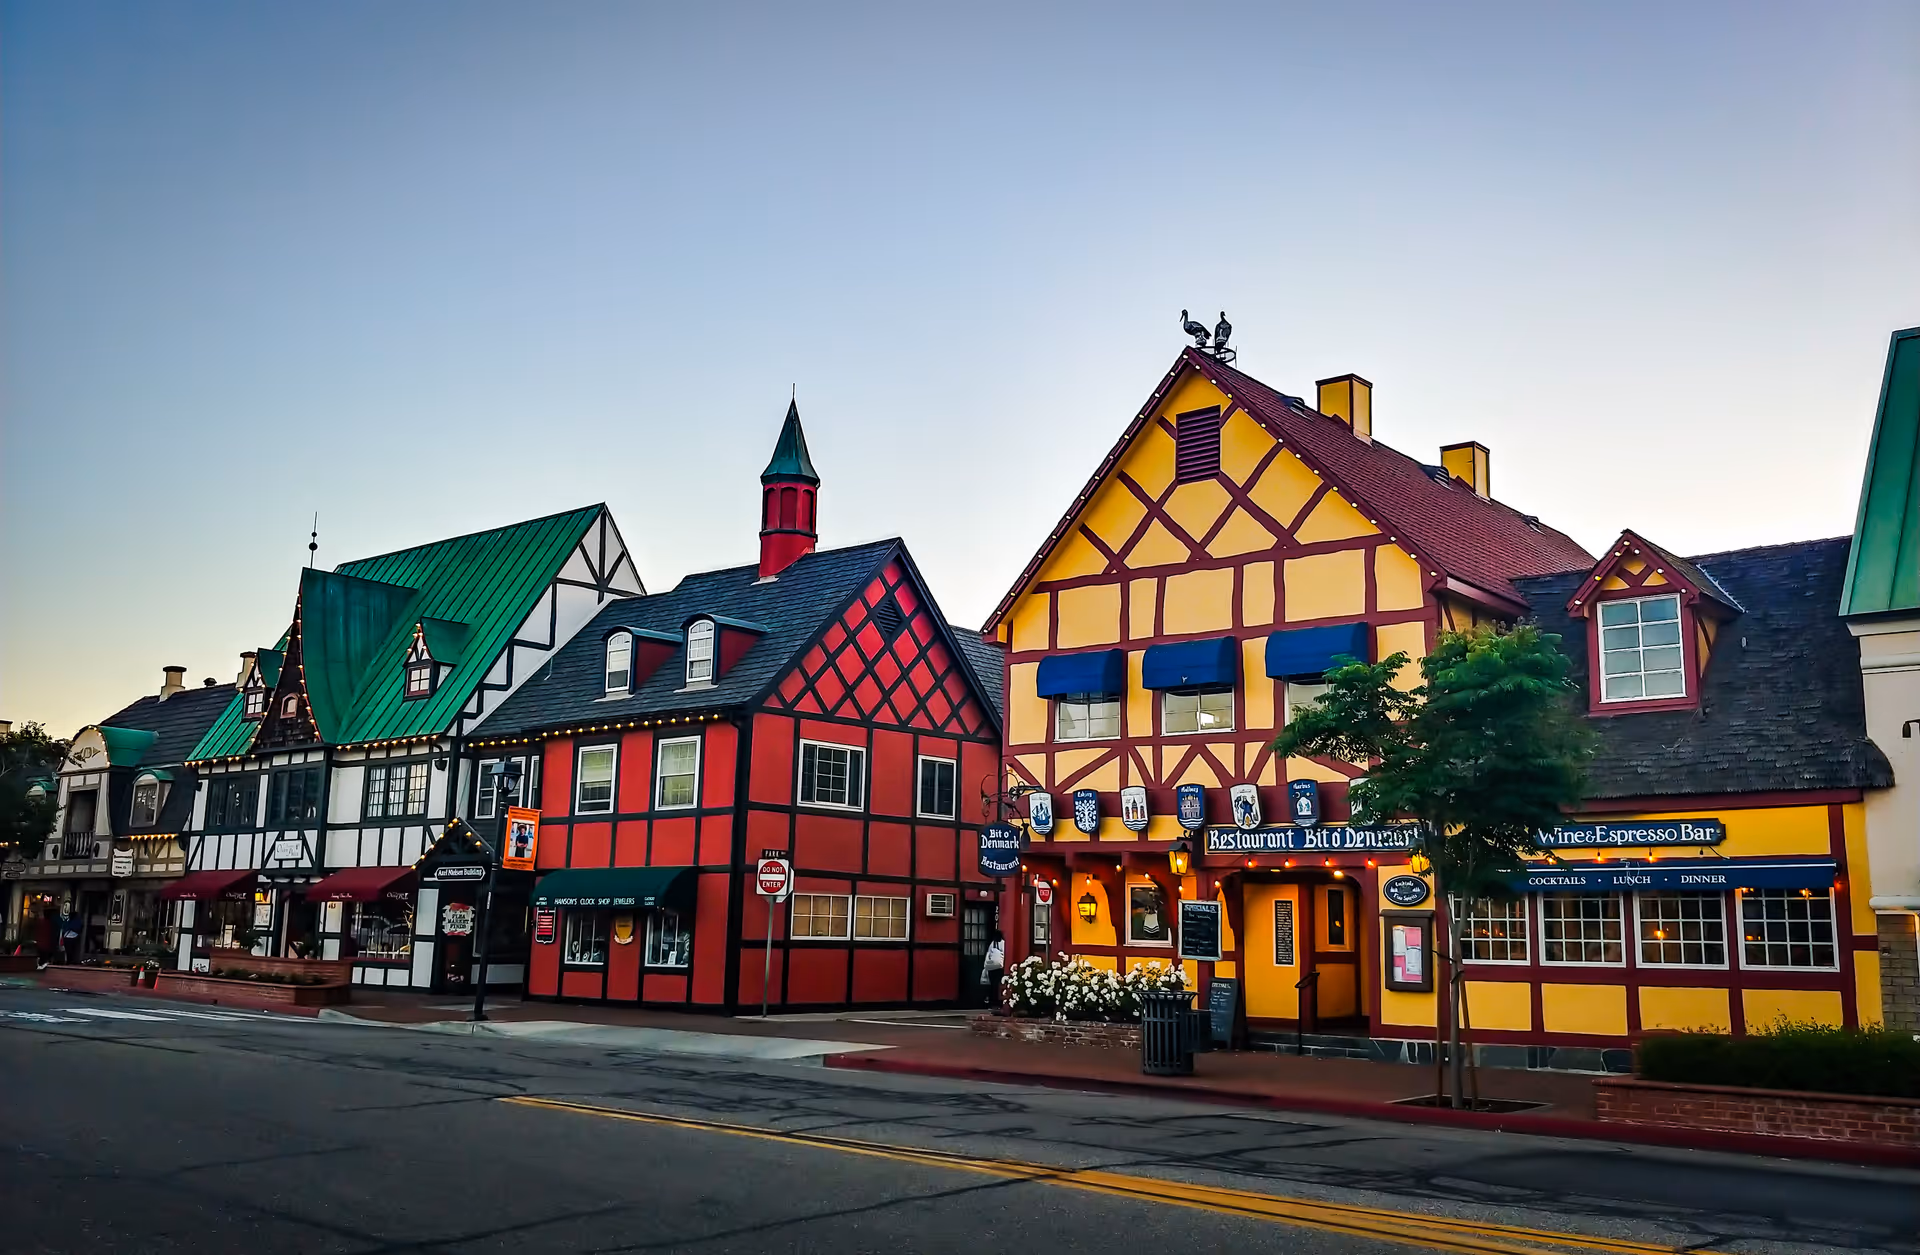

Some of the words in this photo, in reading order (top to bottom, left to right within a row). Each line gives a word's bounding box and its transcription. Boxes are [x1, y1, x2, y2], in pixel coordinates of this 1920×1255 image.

[989, 829, 1002, 839] Bit
[1680, 823, 1715, 841] Bar
[980, 835, 1020, 849] Denmark
[1208, 829, 1295, 850] Restaurant
[1303, 827, 1330, 848] Bit
[980, 855, 1020, 871] Restaurant
[1528, 876, 1587, 886] COCKTAILS
[1613, 875, 1651, 885] LUNCH
[1680, 875, 1727, 884] DINNER
[554, 897, 577, 906] HANSON'S
[580, 897, 596, 906] CLOCK
[597, 897, 611, 906] SHOP
[613, 897, 635, 906] JEWELERS
[1183, 904, 1217, 914] SPECIALS
